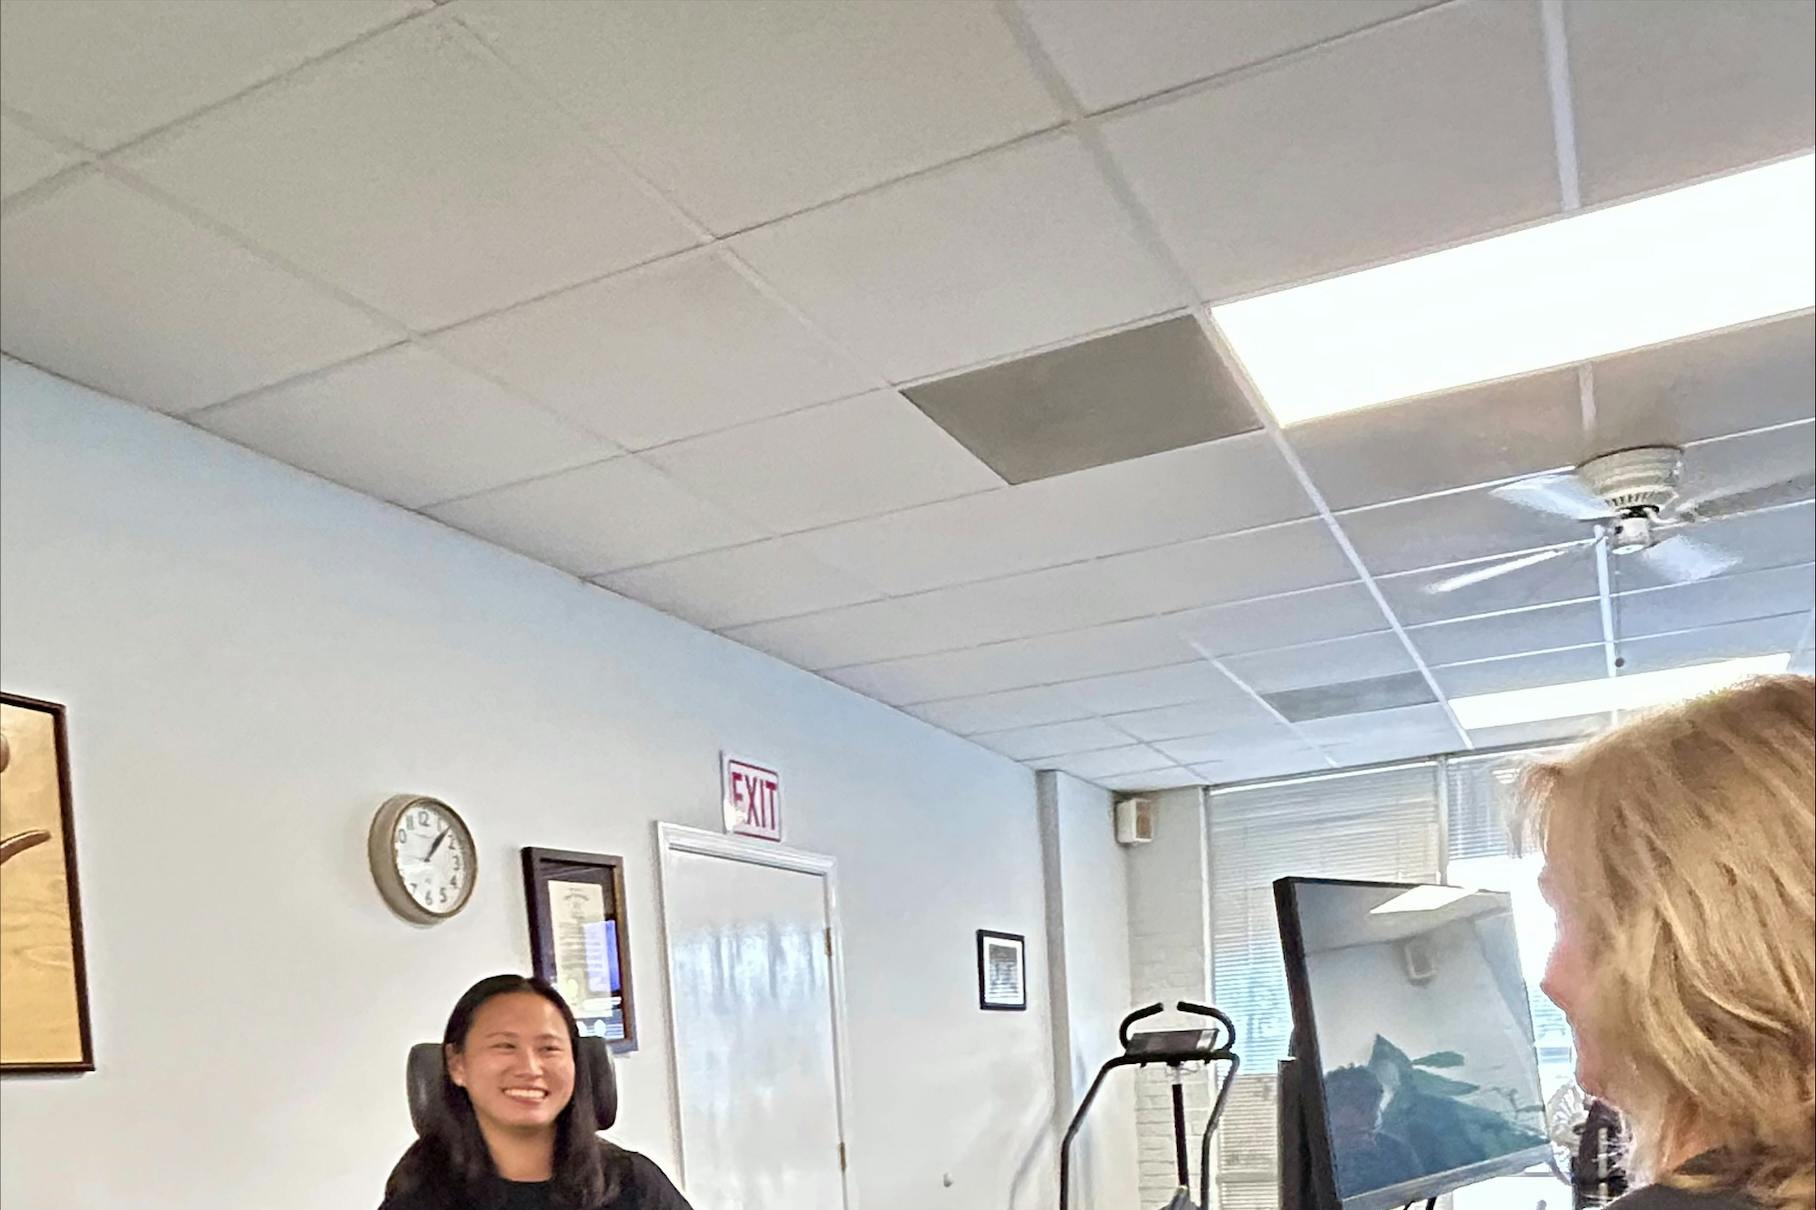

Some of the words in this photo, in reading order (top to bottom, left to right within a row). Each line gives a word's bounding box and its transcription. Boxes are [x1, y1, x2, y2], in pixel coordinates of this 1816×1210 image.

[732, 772, 777, 830] EXIT
[453, 855, 460, 870] 3
[425, 890, 433, 906] 6
[439, 887, 447, 903] 5
